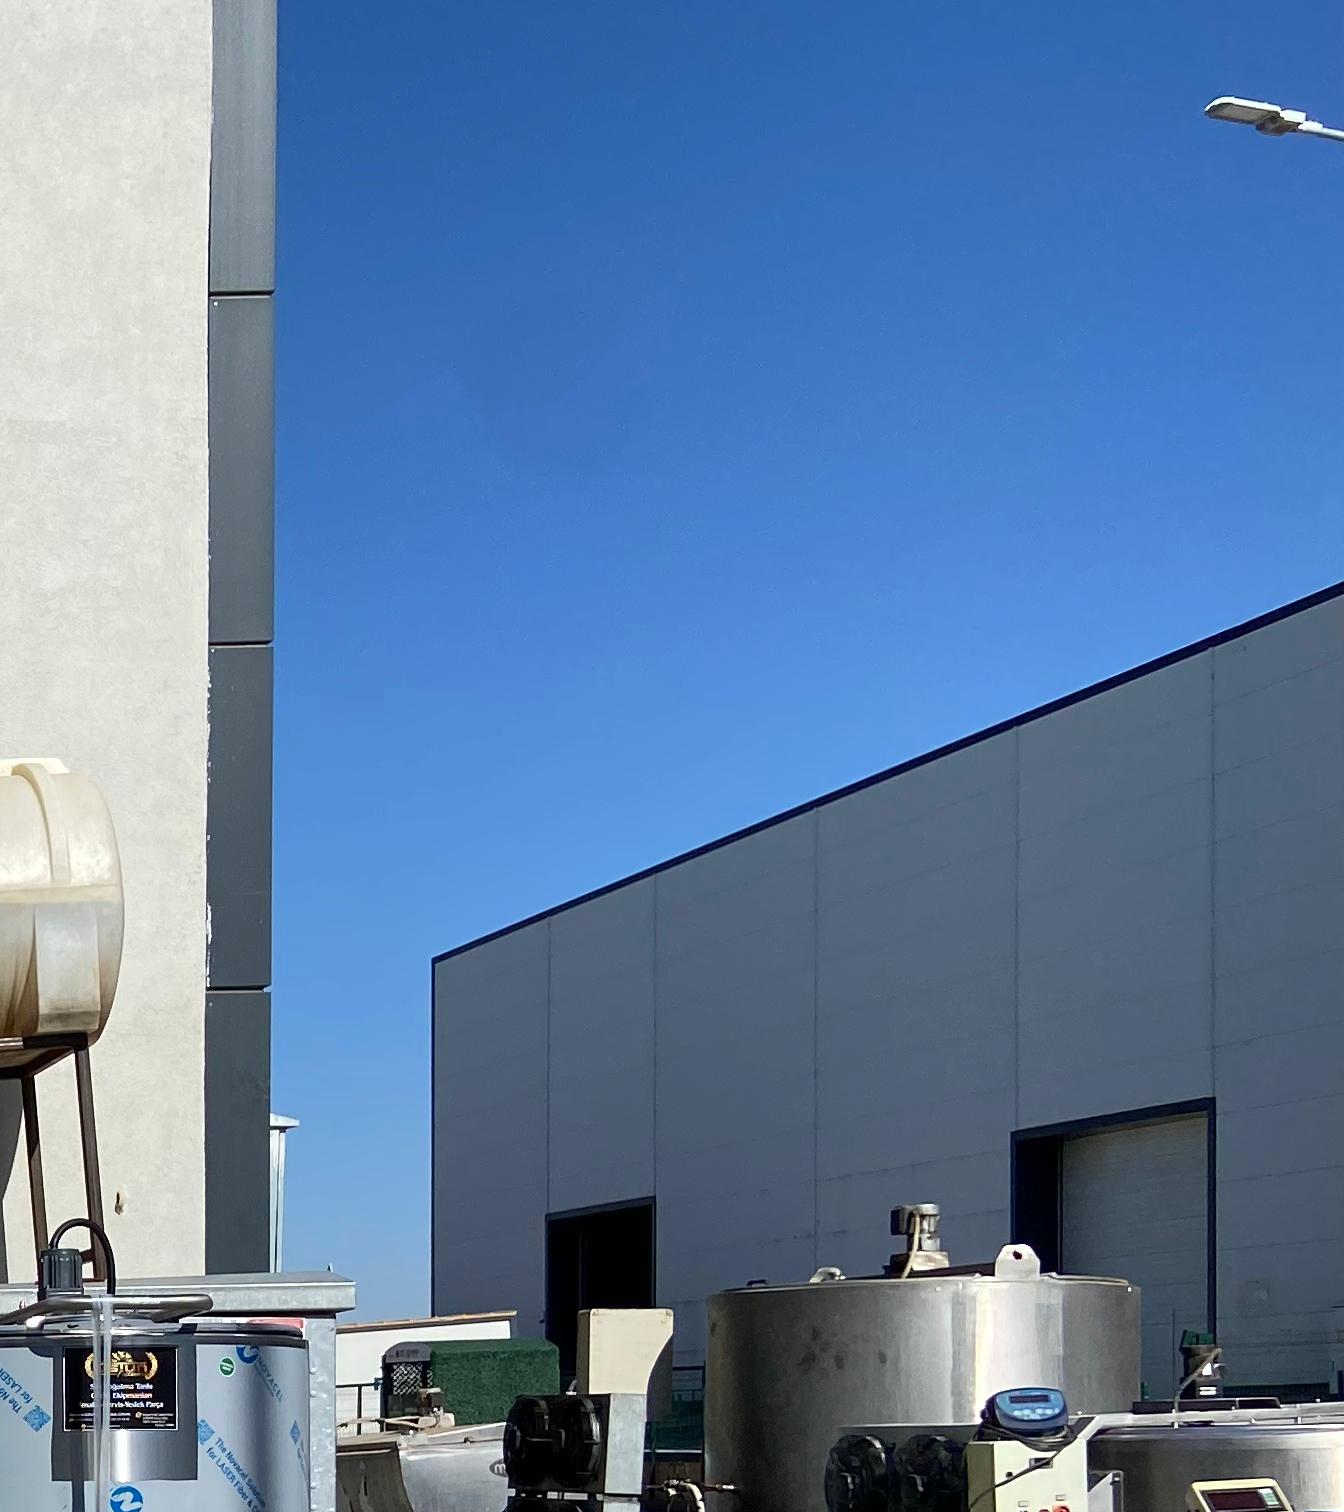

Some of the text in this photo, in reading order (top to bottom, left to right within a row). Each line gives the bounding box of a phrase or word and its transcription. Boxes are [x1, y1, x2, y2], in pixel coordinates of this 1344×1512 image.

[21, 1391, 33, 1404] for
[9, 1398, 22, 1413] The
[214, 1437, 226, 1453] The
[206, 1448, 217, 1462] for
[215, 1457, 236, 1483] LASER
